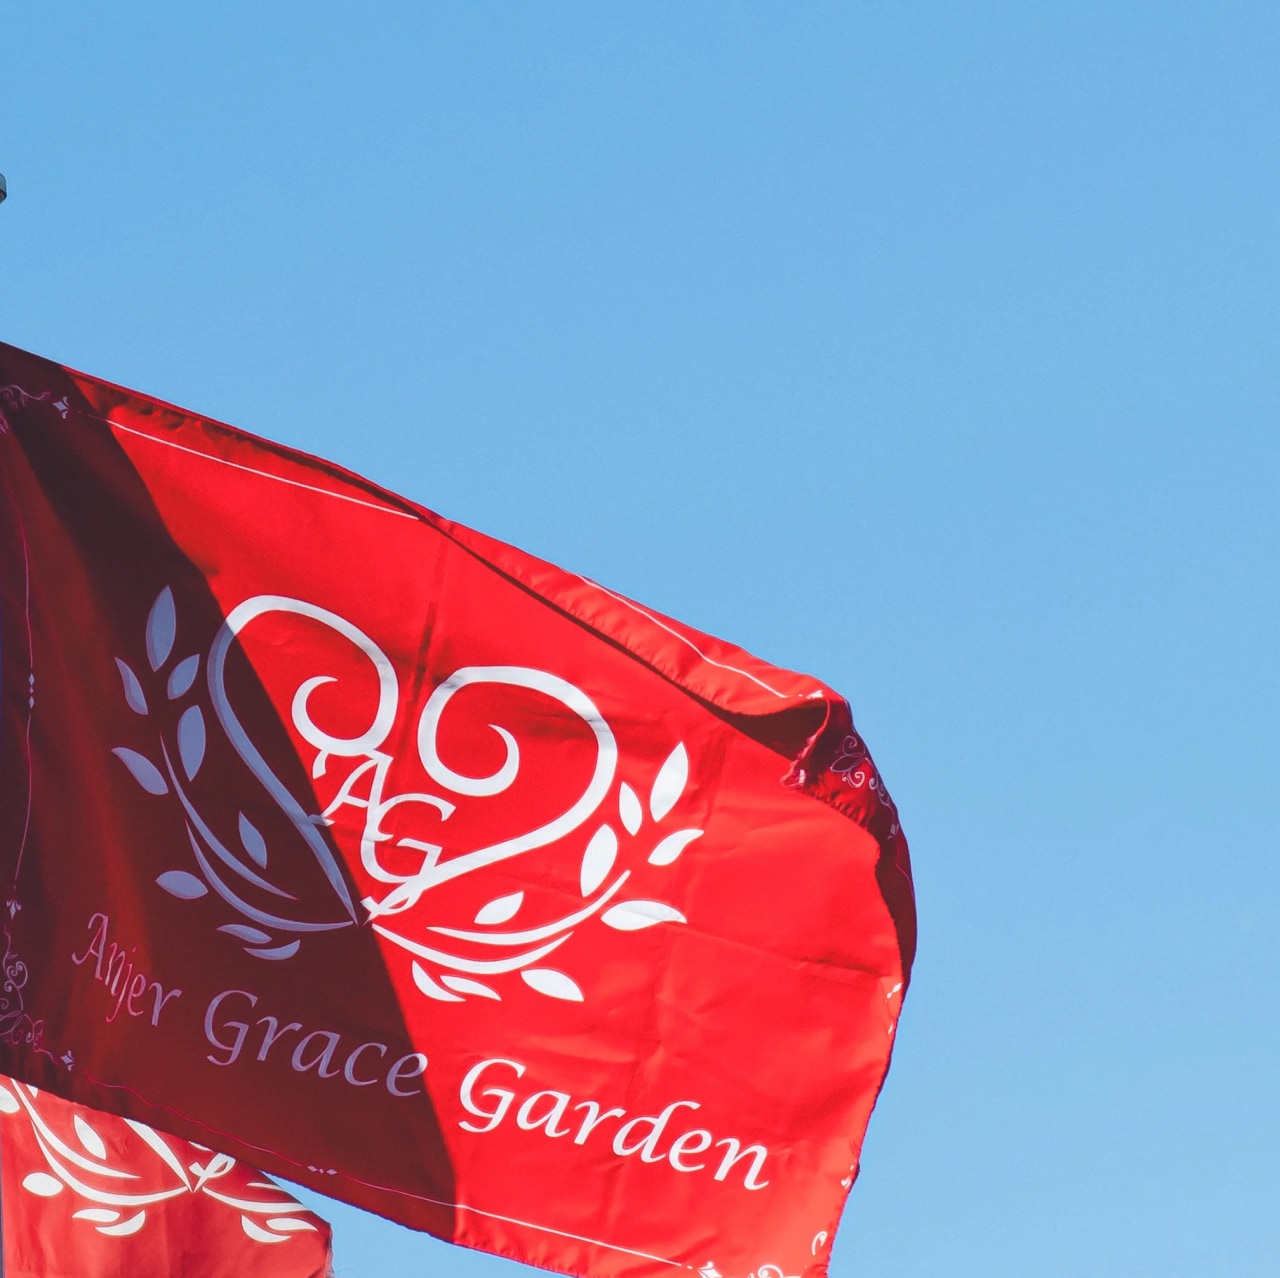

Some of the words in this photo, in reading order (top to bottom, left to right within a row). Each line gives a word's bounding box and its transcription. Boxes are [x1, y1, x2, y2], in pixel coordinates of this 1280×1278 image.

[71, 912, 182, 1026] Anjer
[202, 989, 429, 1098] Grace
[458, 1057, 771, 1192] Garden
